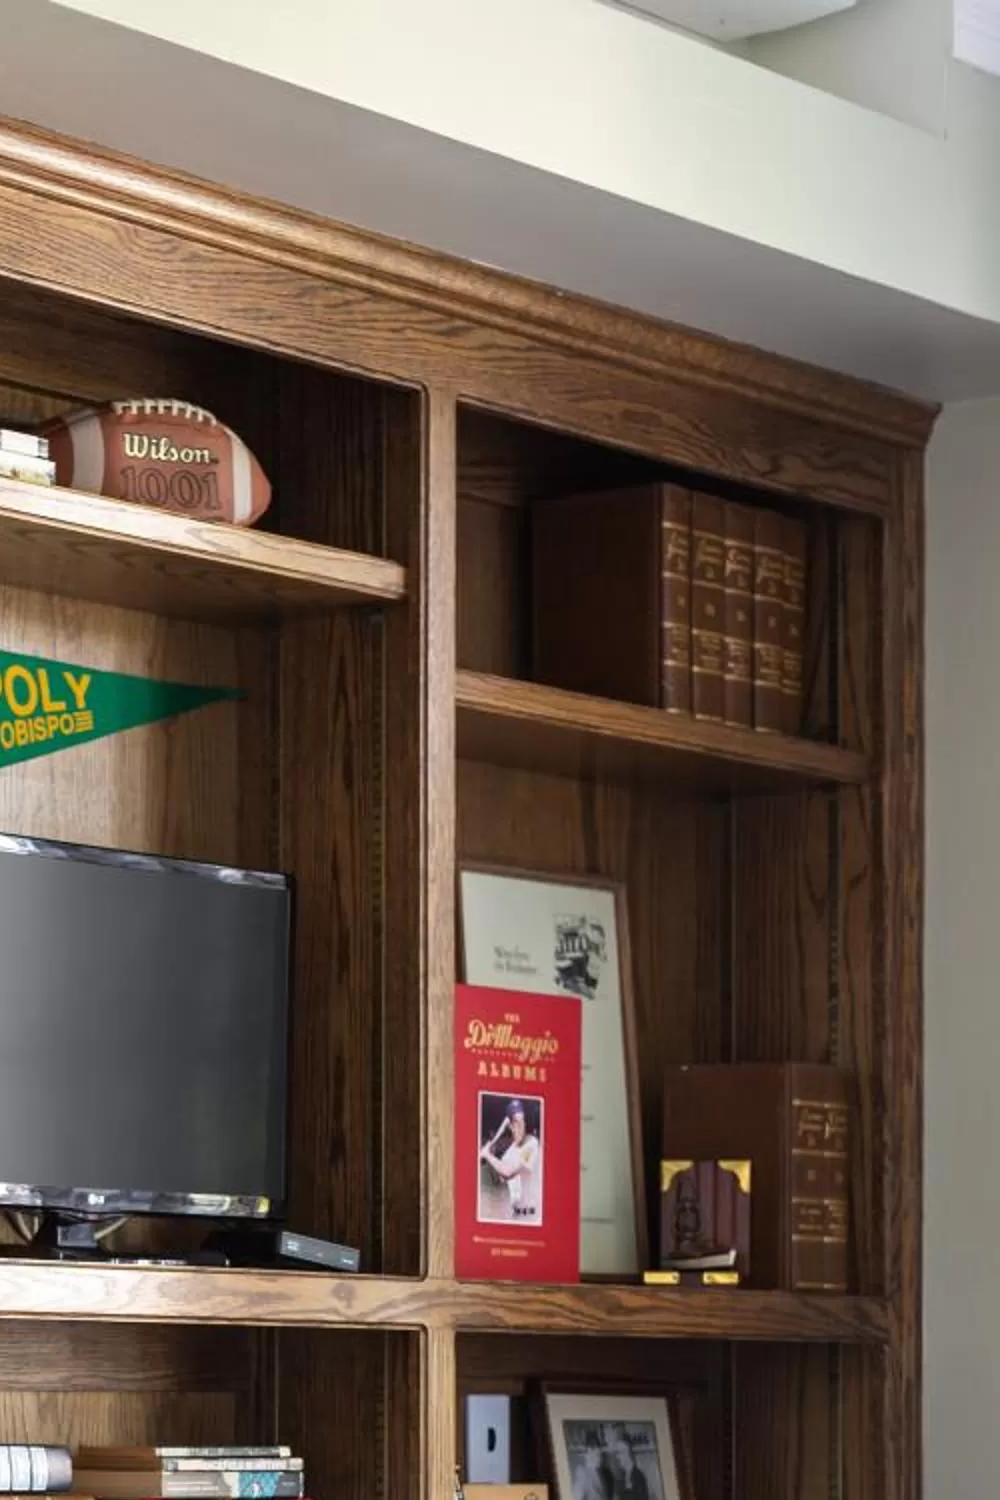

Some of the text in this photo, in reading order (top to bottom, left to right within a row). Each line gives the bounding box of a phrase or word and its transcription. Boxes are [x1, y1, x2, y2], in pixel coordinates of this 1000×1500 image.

[122, 433, 211, 464] Wilson
[120, 465, 222, 511] 1001
[0, 713, 75, 750] OBISPO
[464, 1018, 559, 1065] DiMaggio
